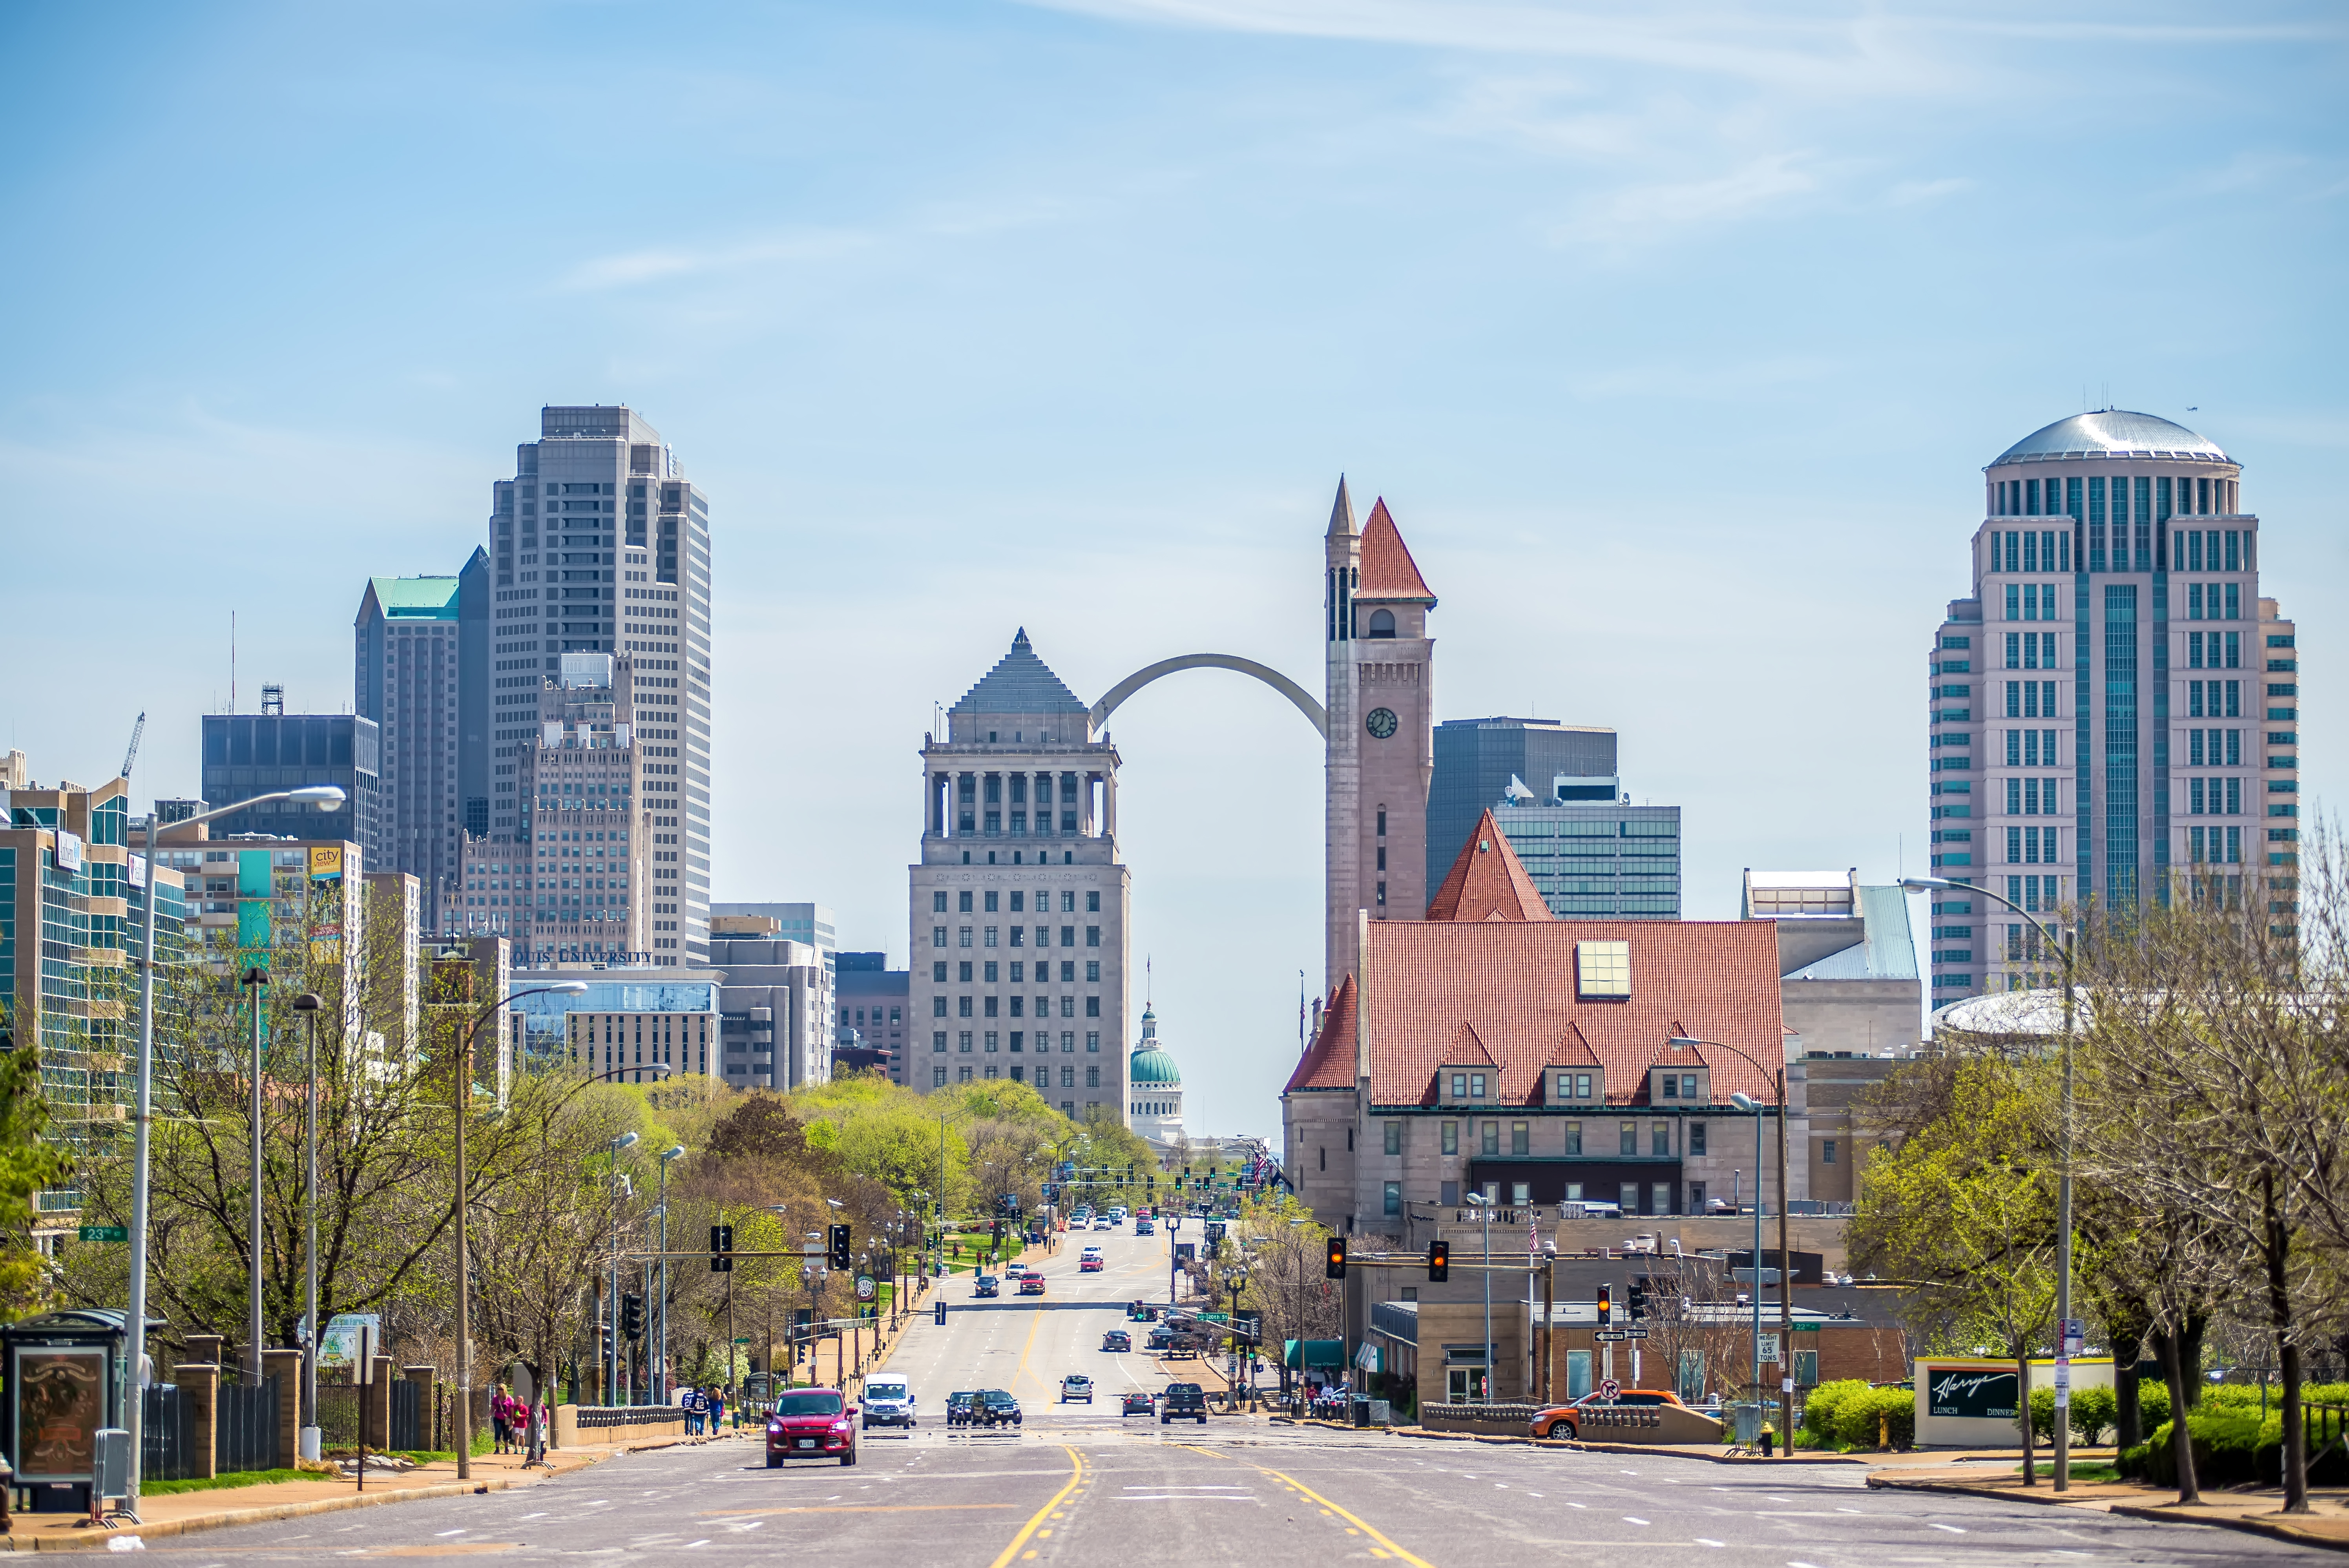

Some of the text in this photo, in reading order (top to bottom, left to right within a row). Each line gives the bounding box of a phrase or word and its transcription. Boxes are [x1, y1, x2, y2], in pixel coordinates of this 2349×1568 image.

[60, 837, 74, 863] Anthem
[316, 850, 339, 862] city
[510, 951, 652, 962] OUIS UNIVERSITY
[695, 1401, 704, 1409] 42
